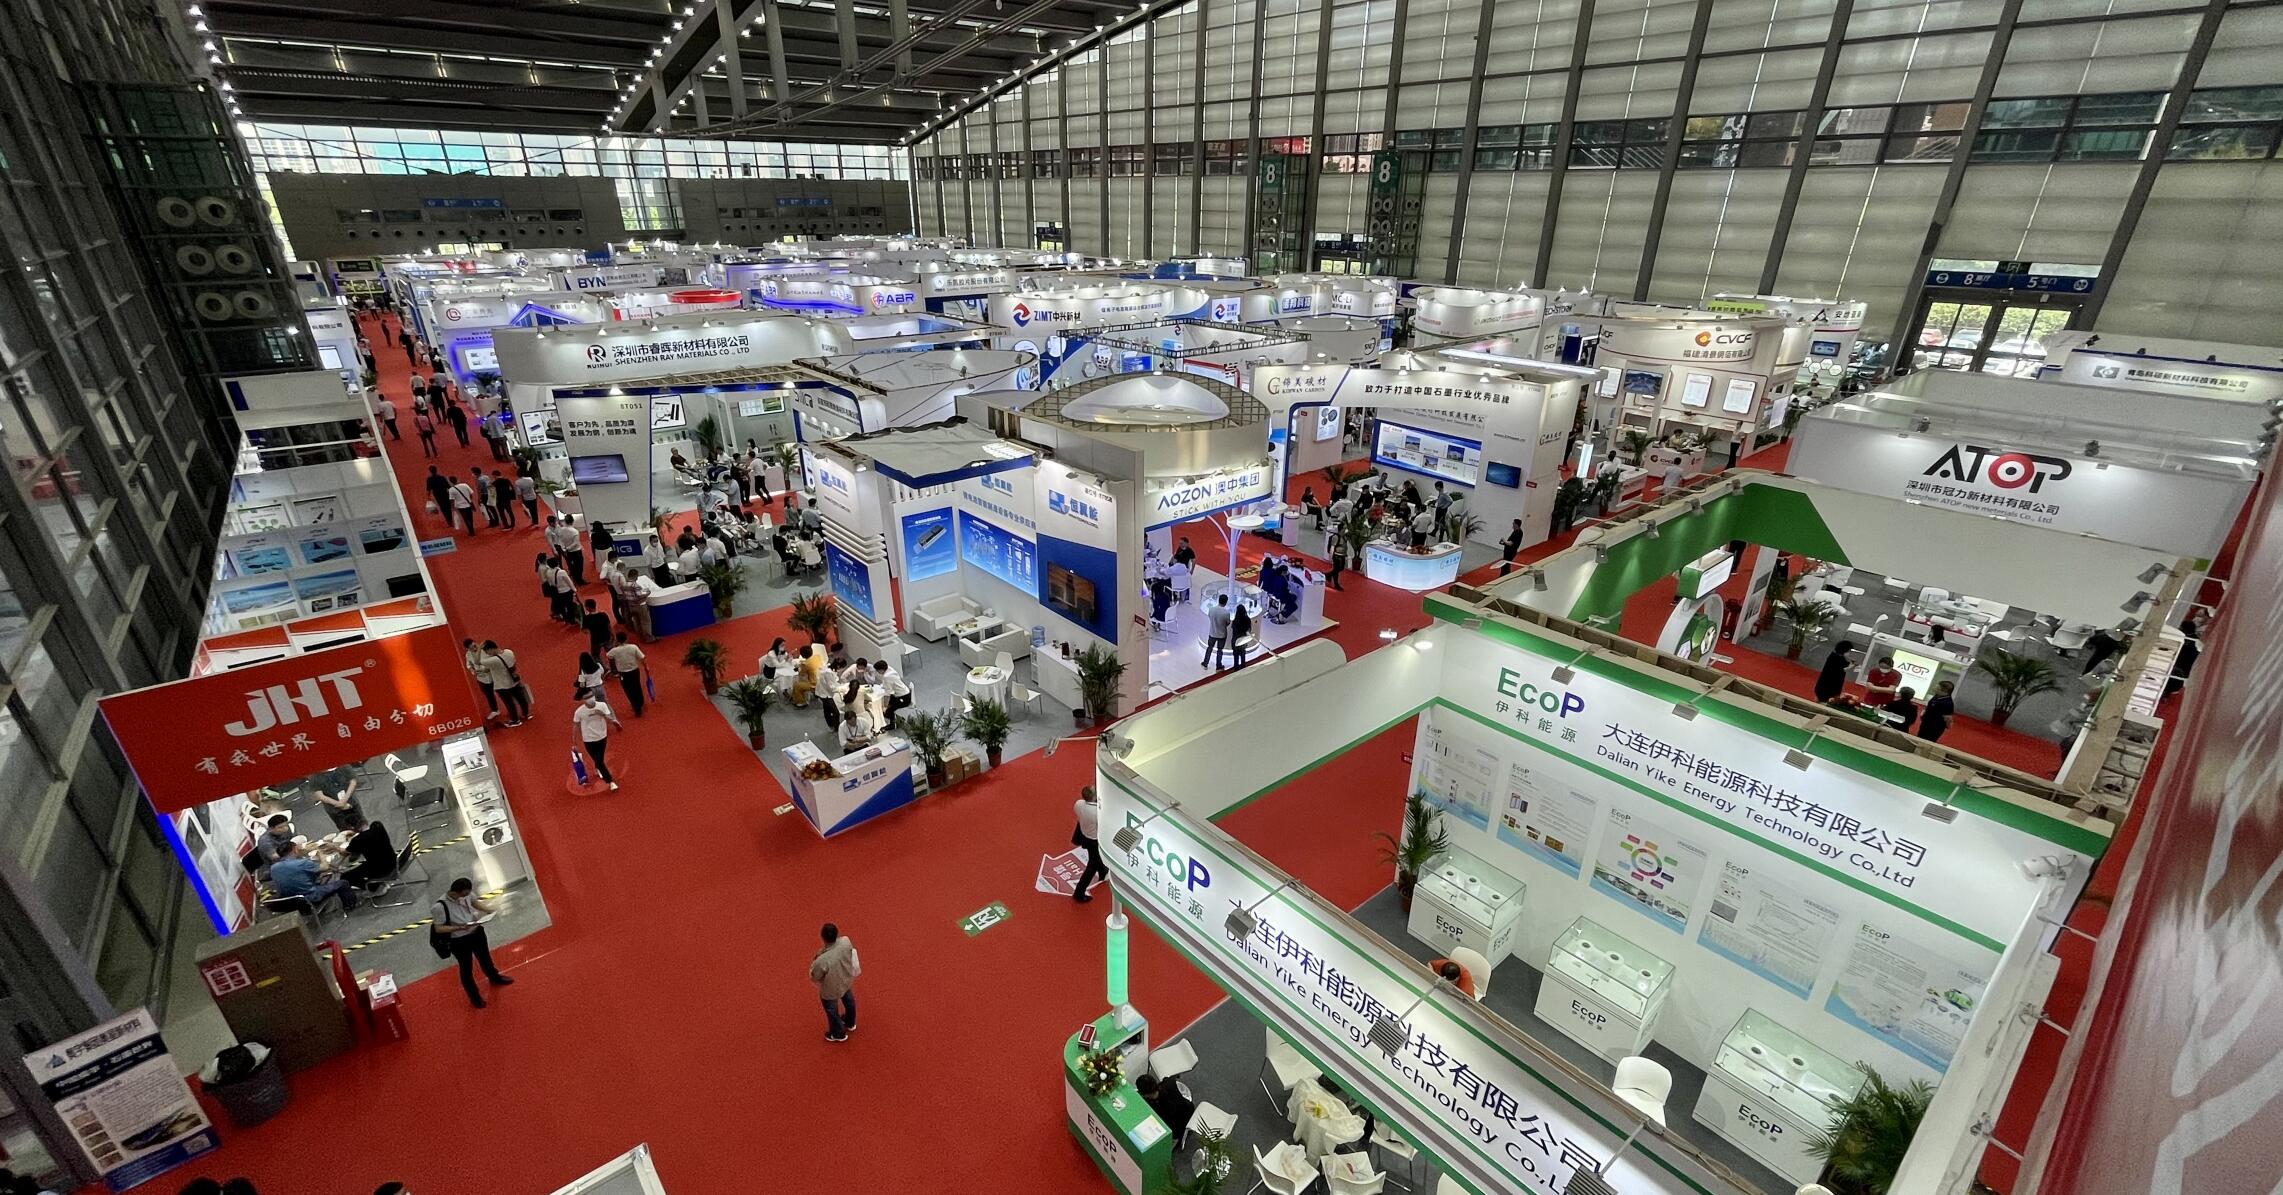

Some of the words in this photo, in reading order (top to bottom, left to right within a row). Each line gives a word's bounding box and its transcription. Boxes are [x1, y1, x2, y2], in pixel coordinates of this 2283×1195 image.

[1267, 164, 1275, 183] 8
[1379, 160, 1391, 183] 8
[578, 276, 606, 288] BYN
[886, 293, 916, 303] ABR
[1716, 333, 1752, 344] CVCF
[615, 355, 658, 366] SHENZHEN
[660, 353, 674, 361] RAY
[677, 349, 718, 360] MATERIALS
[1365, 384, 1510, 404] 致力于打造中国石墨行业优秀品牌
[1923, 444, 2072, 494] ATOP
[1157, 484, 1212, 511] AOZON
[1216, 472, 1260, 494] 澳中集团
[1906, 480, 2060, 515] 深圳市冠力新材料有限公司
[1173, 505, 1199, 518] STICK
[1203, 499, 1225, 510] WITH
[1229, 493, 1246, 503] YOU
[224, 666, 363, 737] JHT
[1498, 667, 1585, 719] EcoP
[428, 717, 472, 736] 8B026
[1495, 700, 1578, 744] 伊科能源
[1602, 722, 1927, 867] 大连伊科能源科技有限公司
[1597, 745, 1639, 772] Dalian
[1646, 765, 1677, 787] Yike
[1683, 782, 1736, 814] Energy
[1745, 807, 1844, 859] Technology
[1850, 852, 1916, 889] Co.,Ltd
[1725, 861, 1749, 875] EcoP
[1127, 852, 1204, 921] 伊科能源
[1436, 915, 1464, 936] EcoP
[1862, 924, 1890, 939] EcoP
[1273, 961, 1307, 998] Yike
[1312, 992, 1371, 1049] Energy
[1572, 1000, 1606, 1023] EcoP
[1738, 1104, 1783, 1135] EcoP
[1088, 1113, 1117, 1153] EcoP
